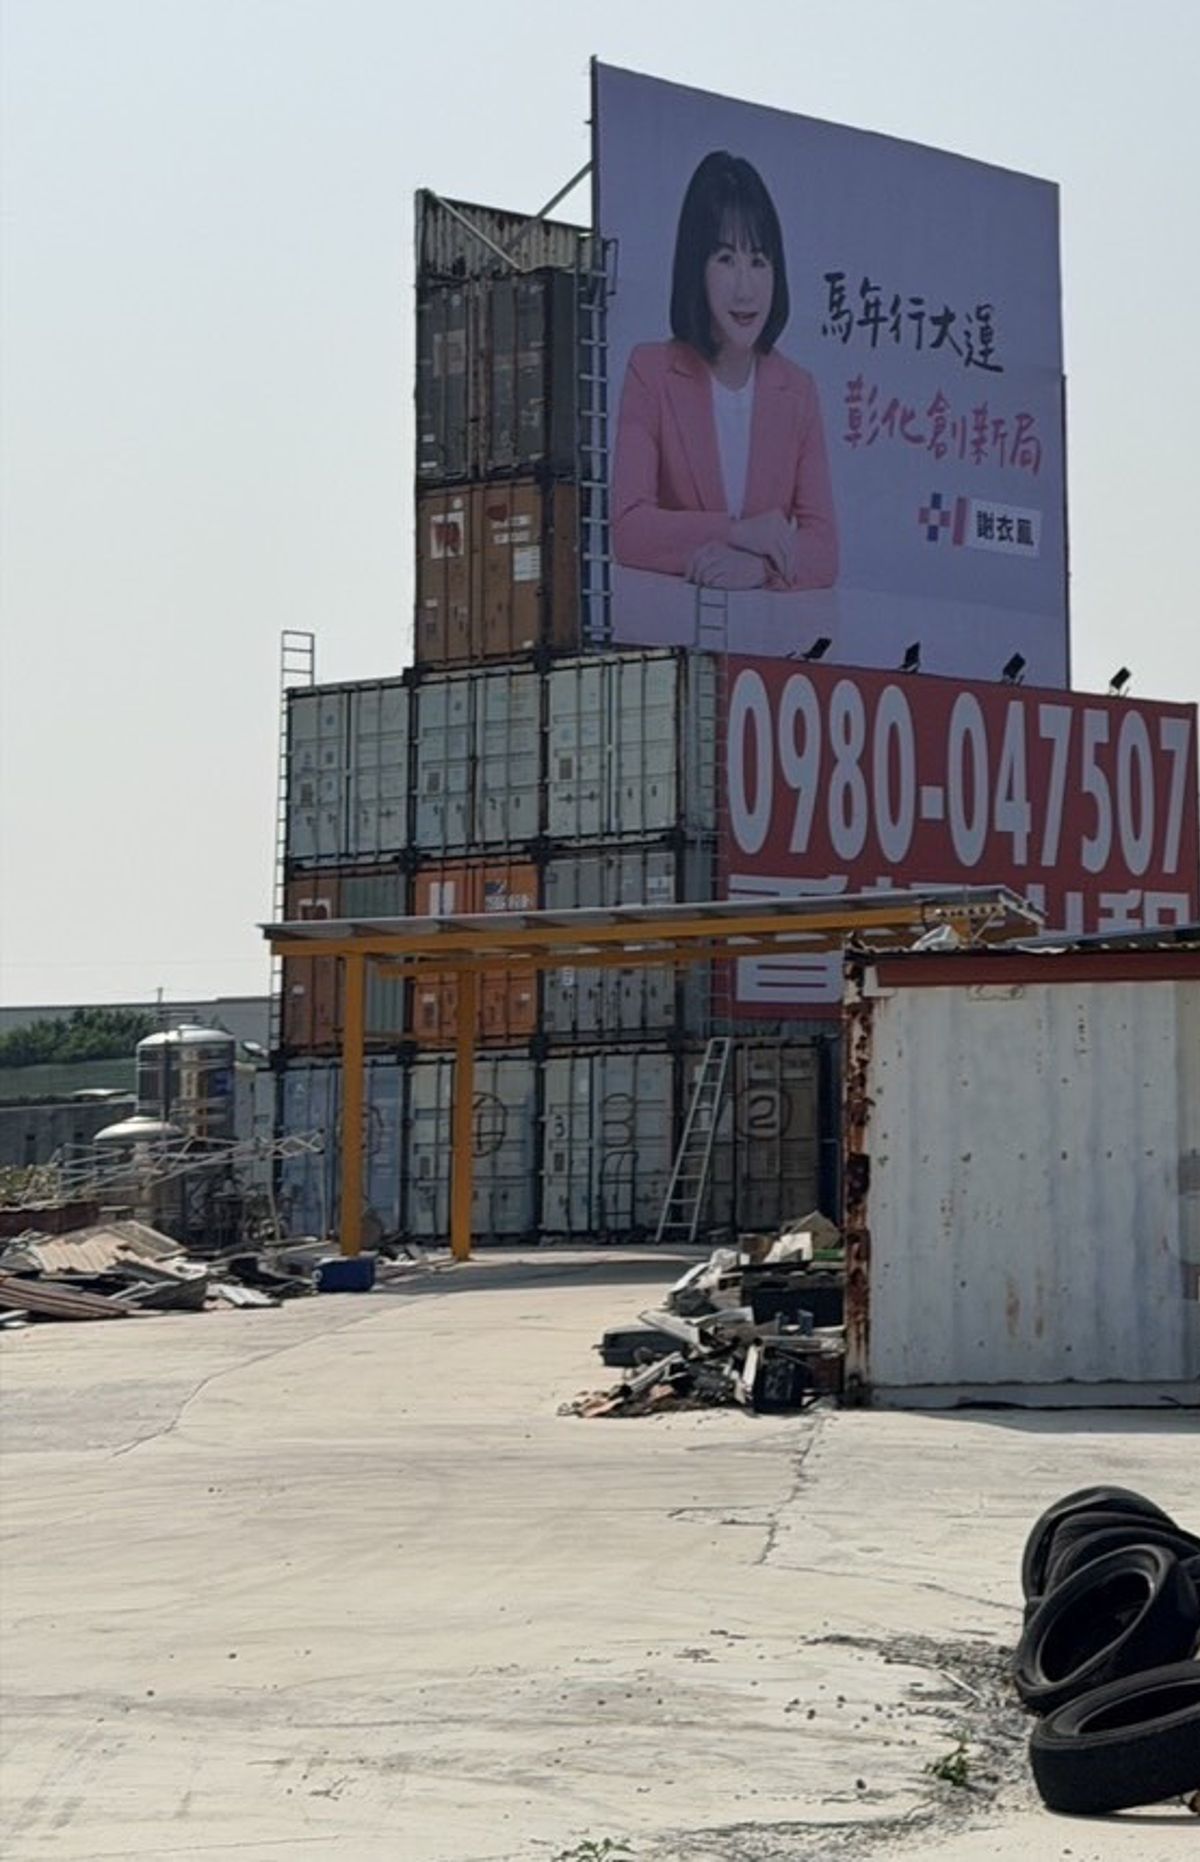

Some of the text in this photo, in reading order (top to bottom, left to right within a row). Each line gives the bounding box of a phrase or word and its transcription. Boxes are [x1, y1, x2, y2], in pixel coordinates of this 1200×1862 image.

[821, 271, 1004, 374] 馬年行大運
[843, 373, 1042, 477] 彰化創新局
[726, 668, 1192, 877] 0980-047507
